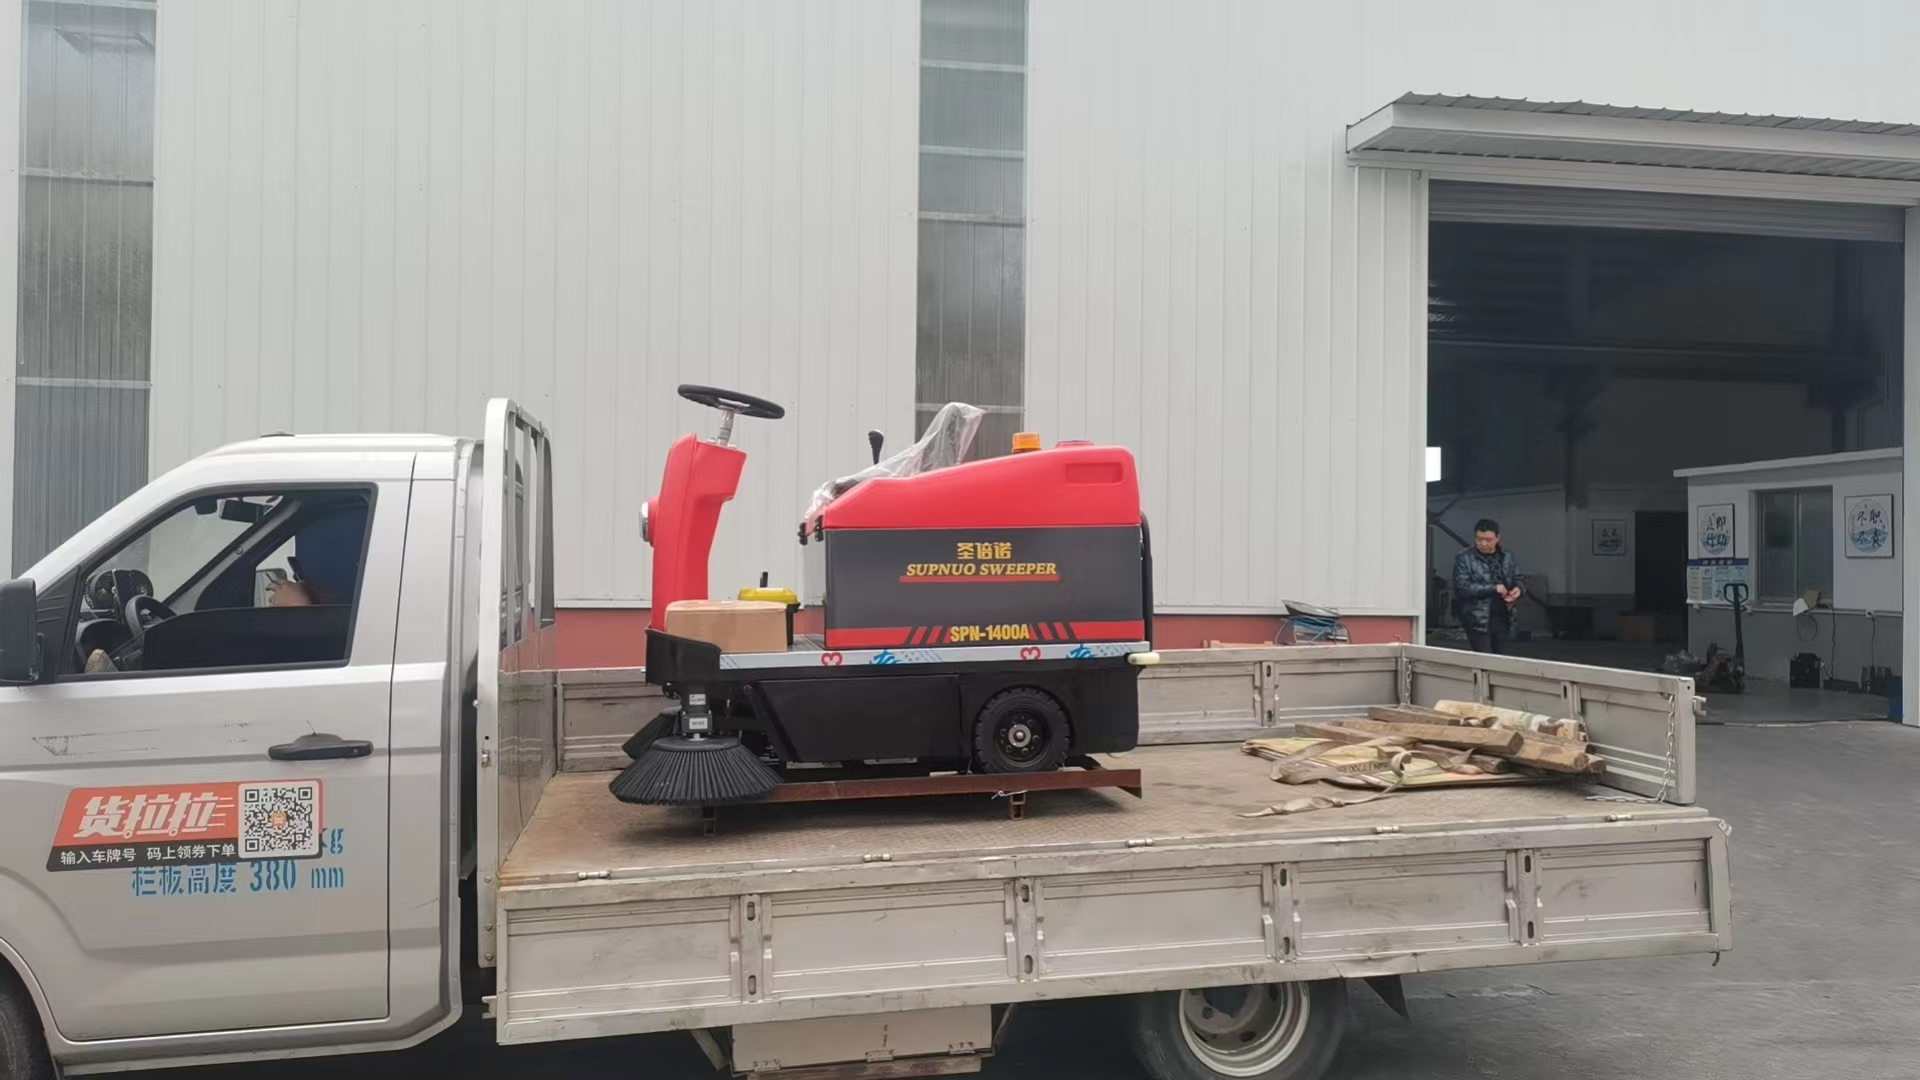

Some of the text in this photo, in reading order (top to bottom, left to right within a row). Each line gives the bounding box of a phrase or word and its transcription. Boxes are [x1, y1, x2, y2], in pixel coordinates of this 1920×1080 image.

[906, 562, 1057, 577] SUPNUO SWEEPER
[950, 623, 1031, 642] SPN-1400A
[73, 792, 219, 839] 货拉拉
[60, 843, 236, 866] 输入车牌号 码上领券下单
[132, 858, 344, 897] 栏板高度 380 mm
